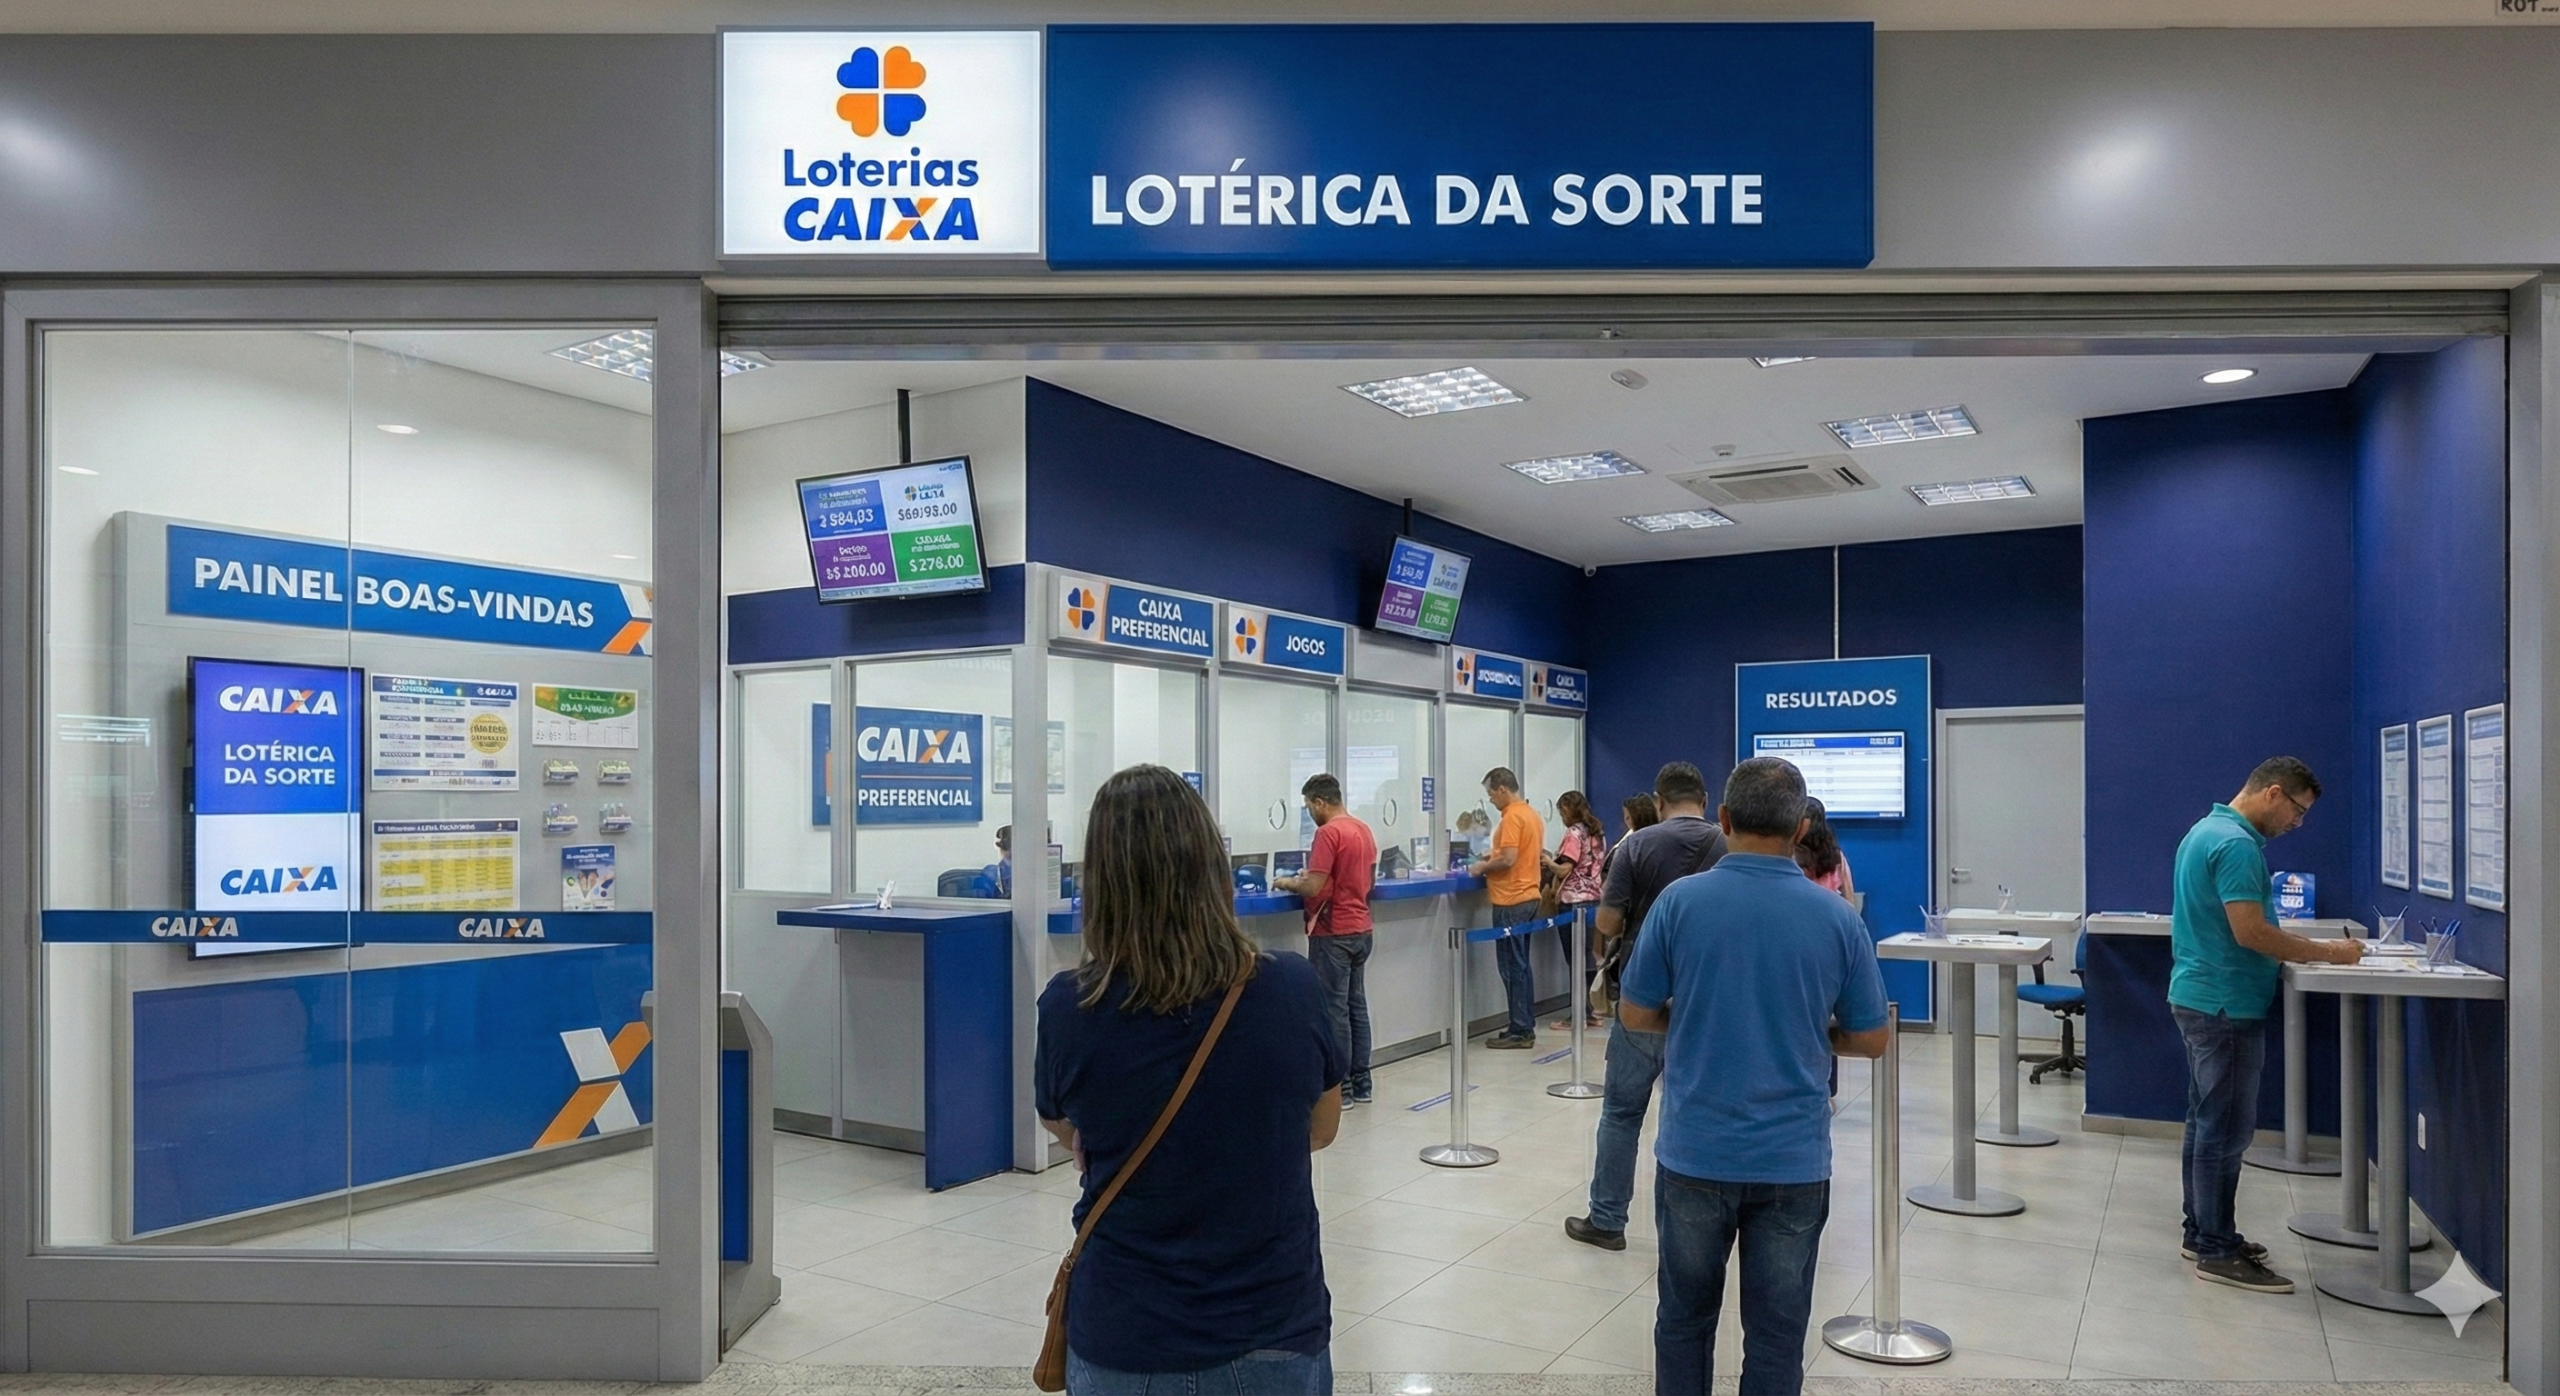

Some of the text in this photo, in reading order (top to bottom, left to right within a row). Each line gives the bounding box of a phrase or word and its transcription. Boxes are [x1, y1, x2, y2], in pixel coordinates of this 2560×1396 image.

[783, 147, 979, 188] Loterias
[1092, 157, 1763, 226] LOTÉRICA DA SORTE
[783, 196, 979, 242] CAIXA
[195, 557, 594, 628] PAINEL BOAS-VINDAS
[1138, 598, 1183, 622] CAIXA
[1111, 615, 1209, 648] PREFERENCIAL
[1286, 635, 1325, 656] JOGOS
[219, 685, 338, 716] CAIXA
[1766, 688, 1897, 709] RESULTADOS
[224, 739, 335, 763] LOTÉRICA
[857, 726, 972, 764] CAIXA
[224, 767, 335, 785] DA SORTE
[858, 788, 972, 807] PREFERENCIAL
[219, 864, 339, 896] CAIXA
[151, 916, 239, 938] CAIXA
[458, 917, 545, 939] CAIXA
